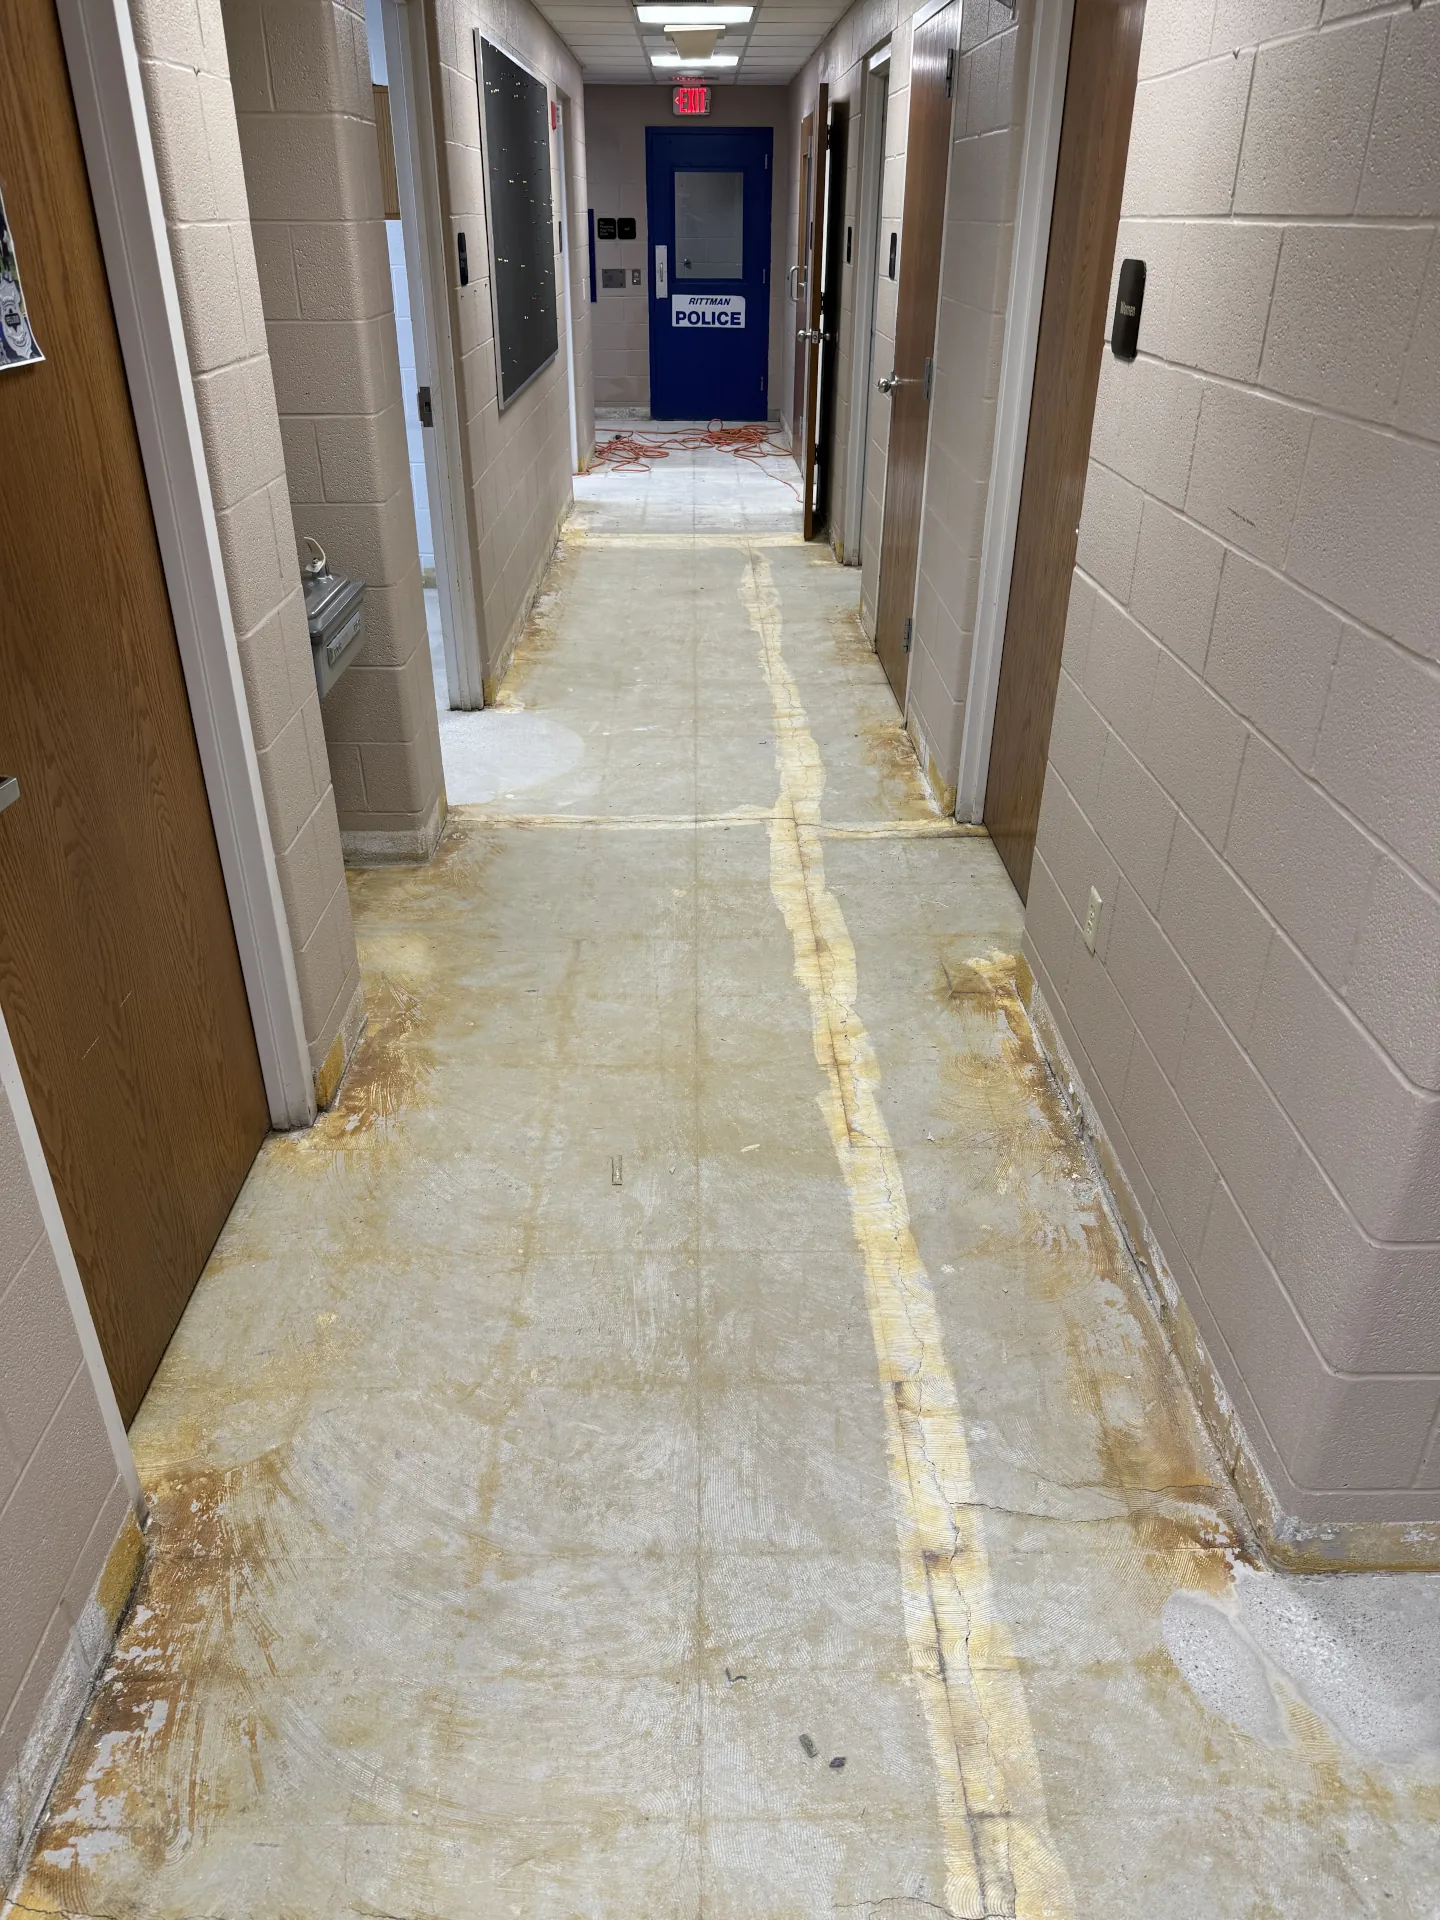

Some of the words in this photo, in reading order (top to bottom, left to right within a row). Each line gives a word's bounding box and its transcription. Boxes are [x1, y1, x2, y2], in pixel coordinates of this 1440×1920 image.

[679, 88, 707, 113] EXIT
[688, 297, 731, 306] RITTMAN
[1120, 300, 1136, 317] Women
[675, 310, 742, 326] POLICE
